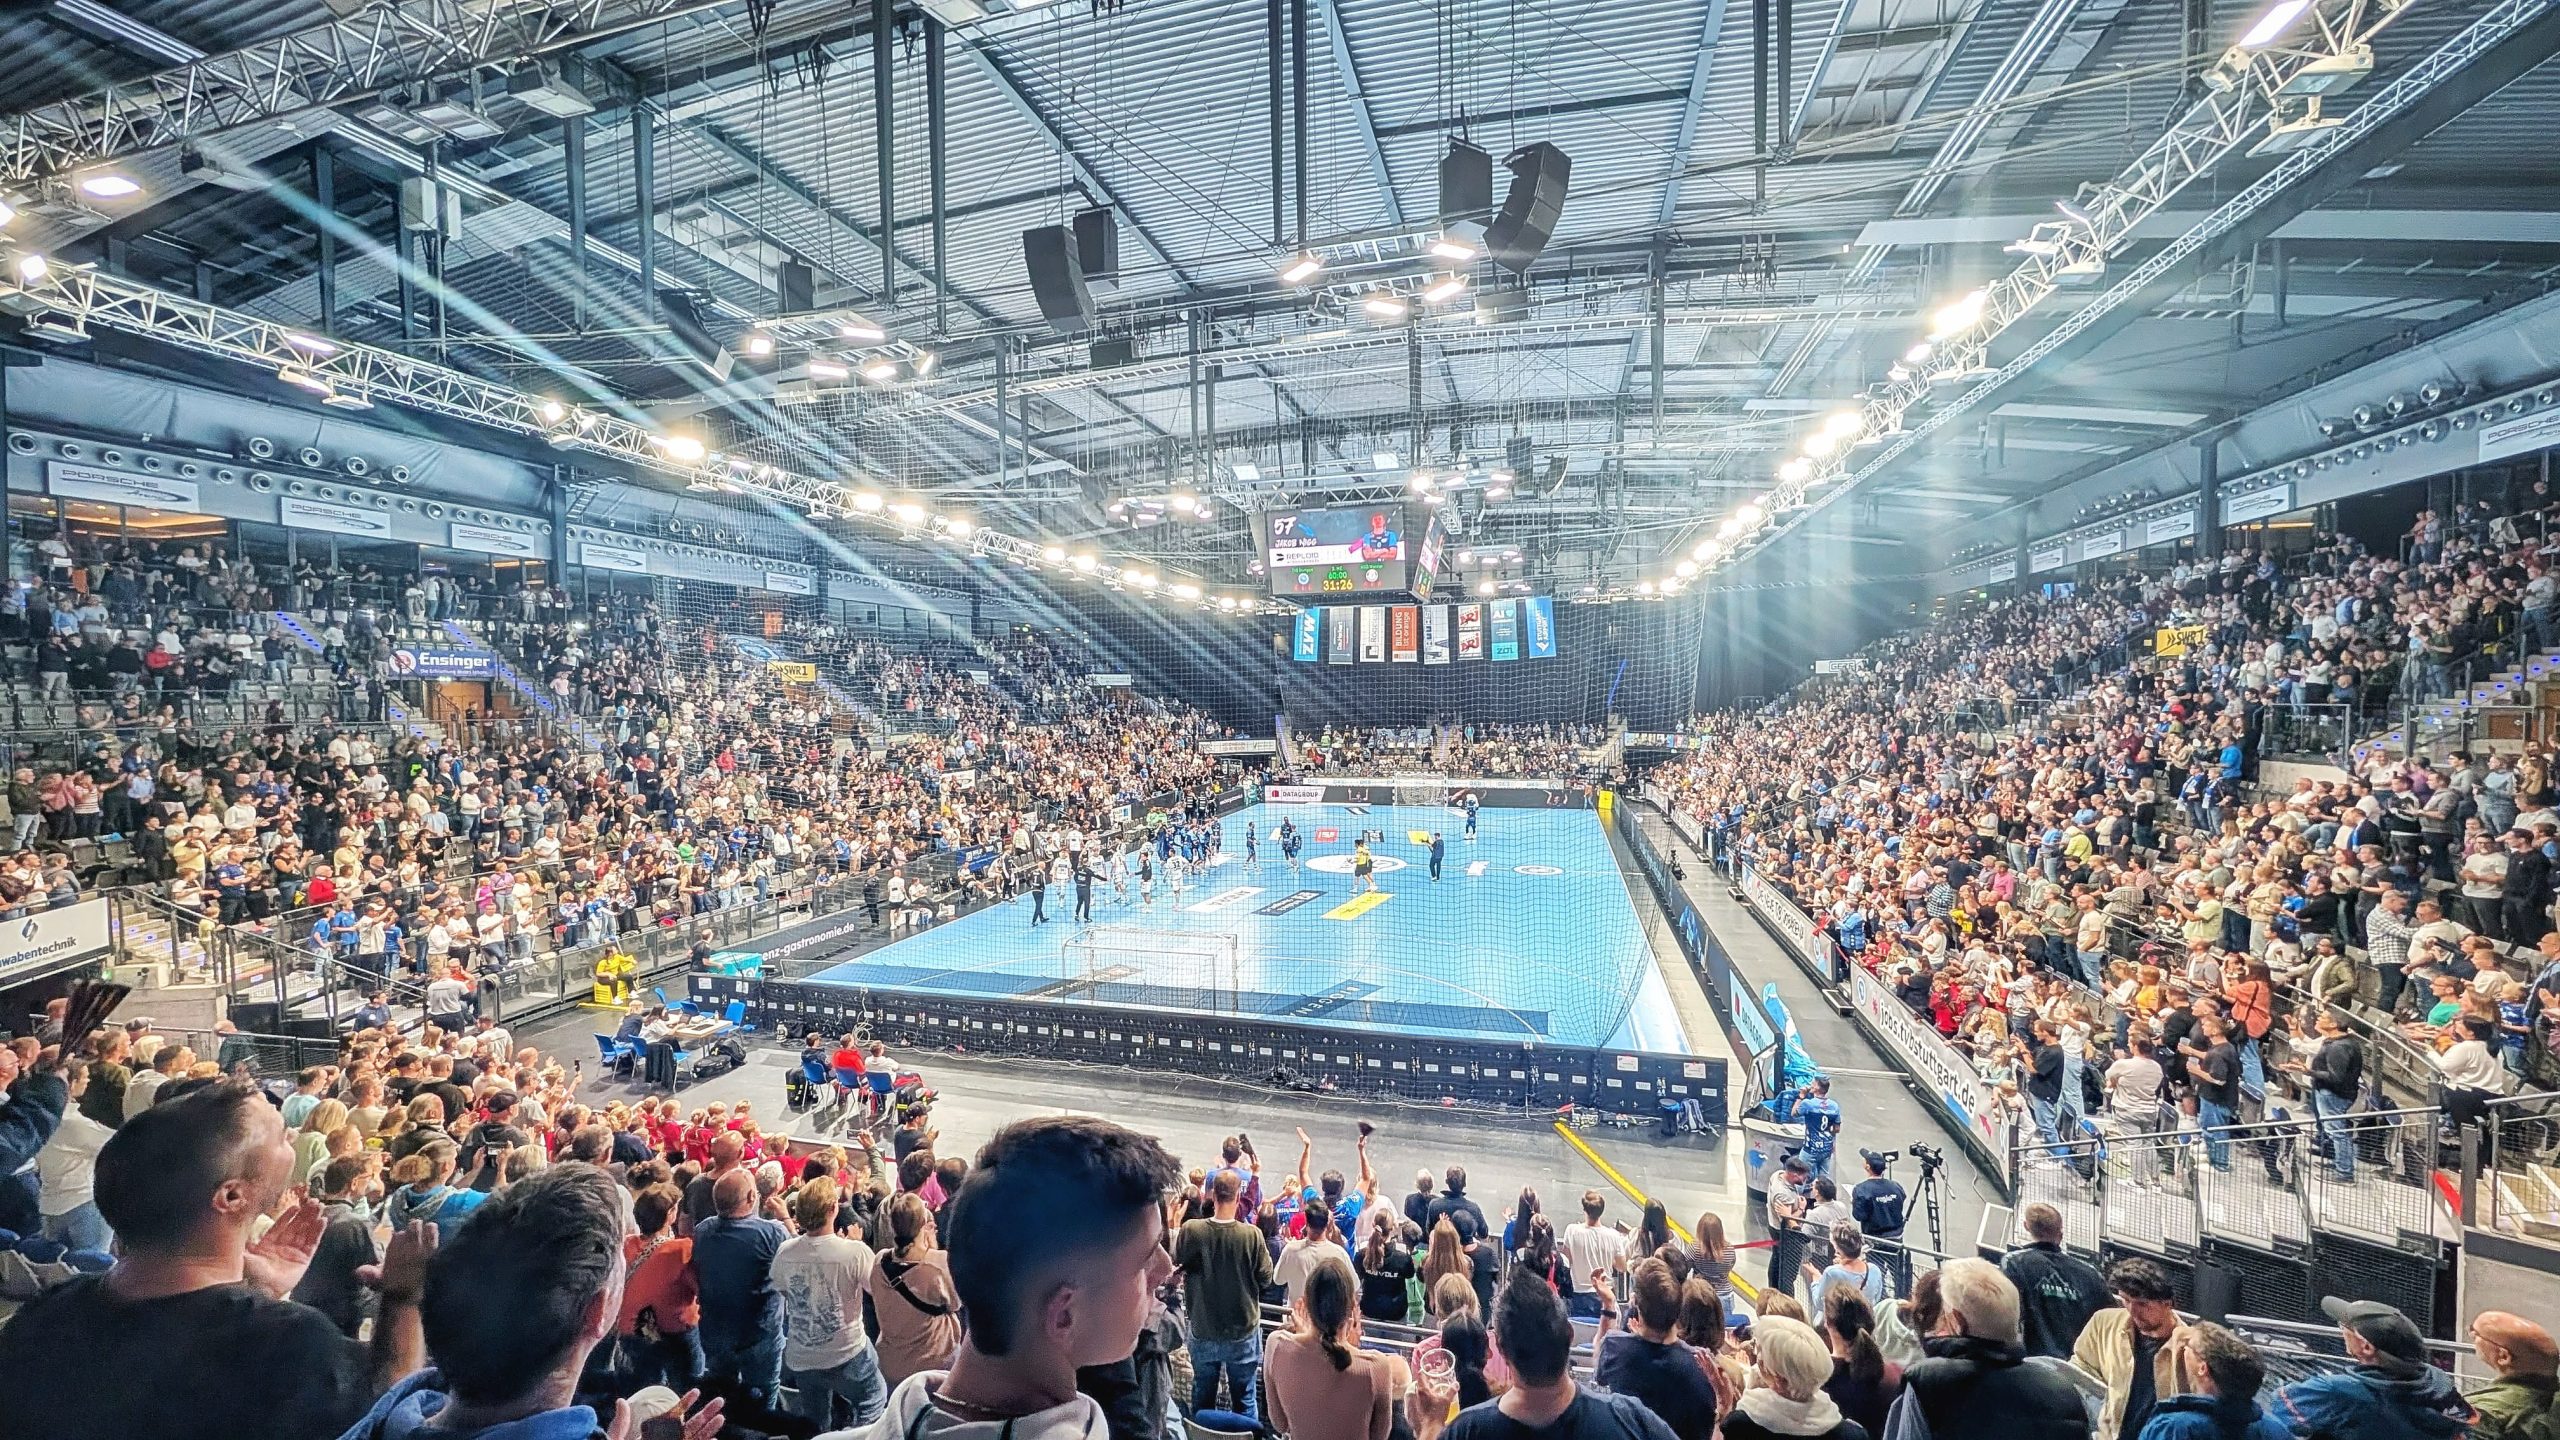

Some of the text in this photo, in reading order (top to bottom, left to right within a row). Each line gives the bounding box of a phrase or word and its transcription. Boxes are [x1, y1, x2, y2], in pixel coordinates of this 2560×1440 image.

[2488, 414, 2560, 440] PORSCHE
[62, 469, 159, 489] PORSCHE
[291, 503, 361, 519] PORSCHE
[458, 529, 512, 541] PORSCHE
[1274, 516, 1296, 535] 57
[1274, 540, 1297, 548] JAKOB
[1328, 571, 1348, 579] 60:00
[1323, 579, 1353, 591] 31:26
[1395, 611, 1403, 647] BILDUNG
[1403, 611, 1411, 637] orange
[1302, 613, 1316, 655] ZVW
[419, 652, 490, 669] Ensinger
[762, 922, 855, 962] enz-gastronomie.de
[1879, 1000, 1976, 1114] jobs.tvbstuttgart.de
[1820, 1115, 1829, 1132] 8
